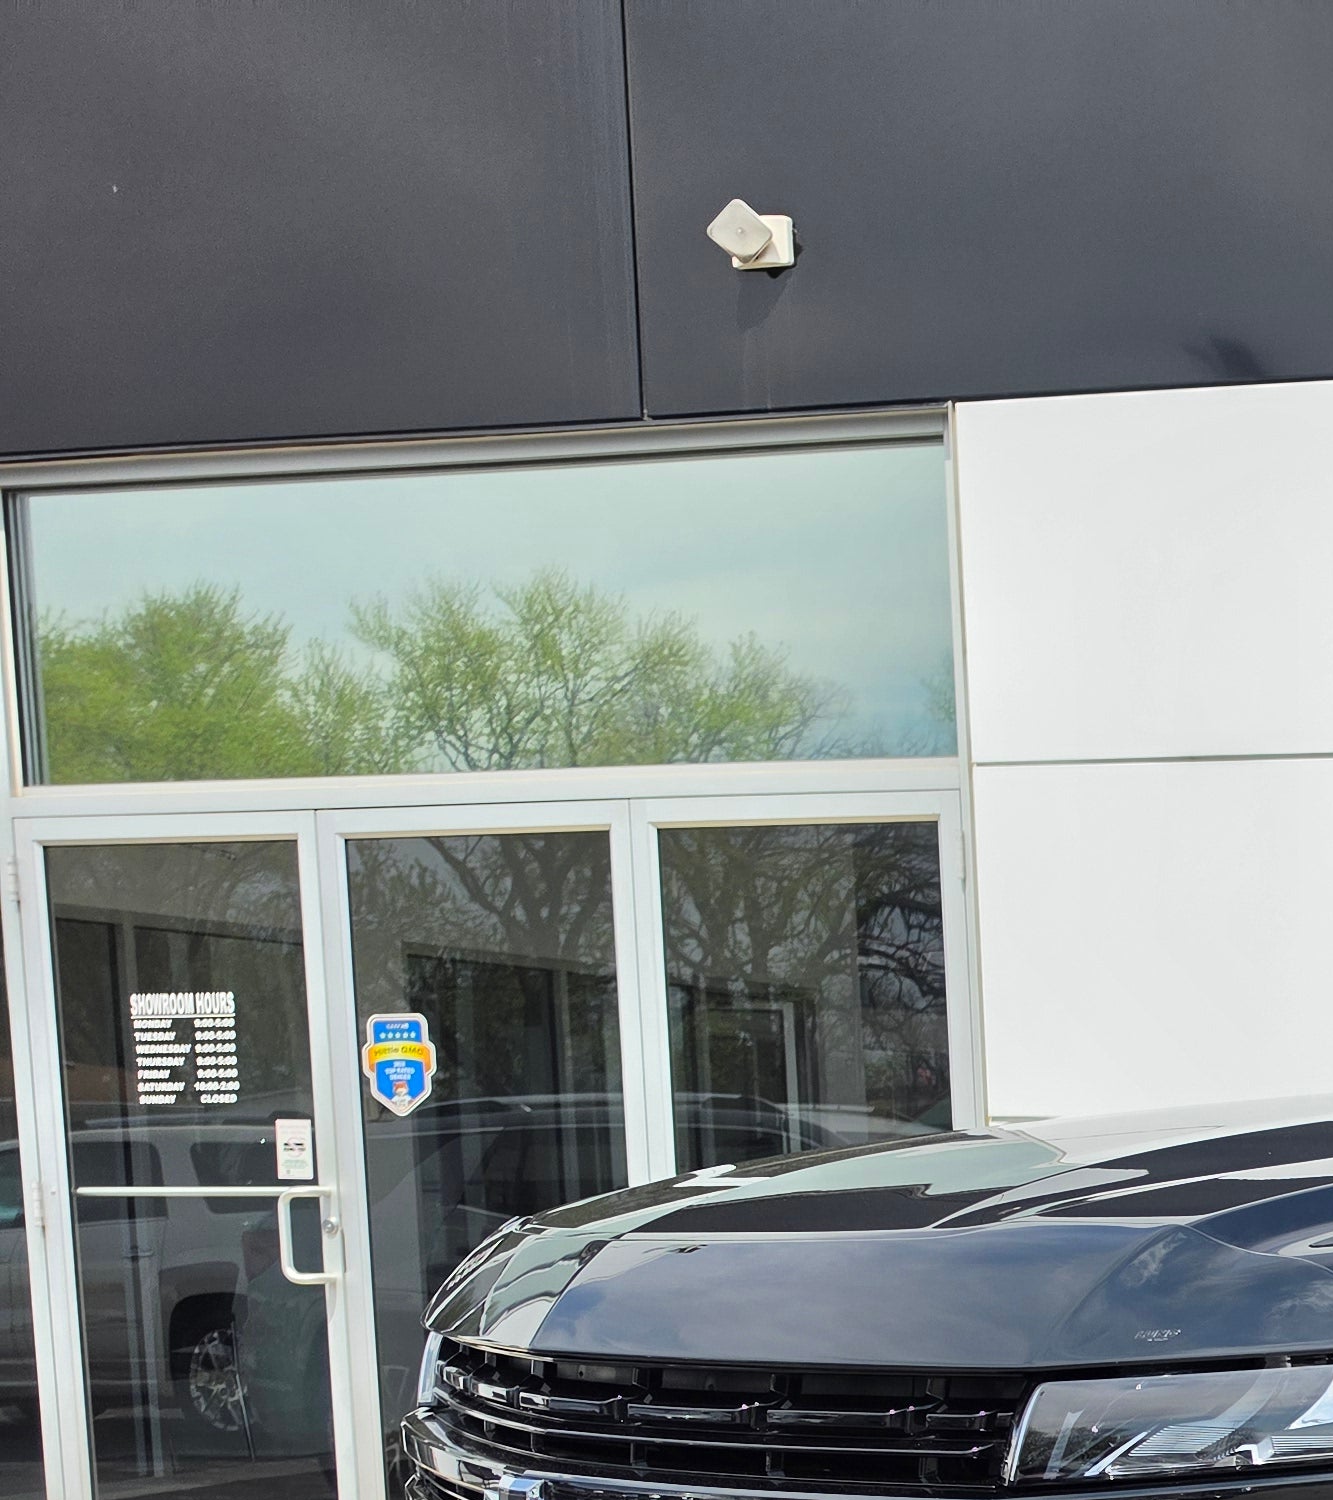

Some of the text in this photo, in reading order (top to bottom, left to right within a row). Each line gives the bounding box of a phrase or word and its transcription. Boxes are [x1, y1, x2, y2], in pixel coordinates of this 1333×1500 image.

[130, 991, 236, 1016] SHOWROOM HOURS
[133, 1019, 173, 1029] MONDAY
[133, 1031, 177, 1041] TUESDAY
[135, 1043, 192, 1054] WEDNESDAY
[136, 1056, 186, 1067] THURSDAY
[137, 1069, 171, 1079] FRIDAY
[137, 1081, 186, 1092] SATURDAY
[139, 1093, 238, 1105] SUNDAY CLOSED
